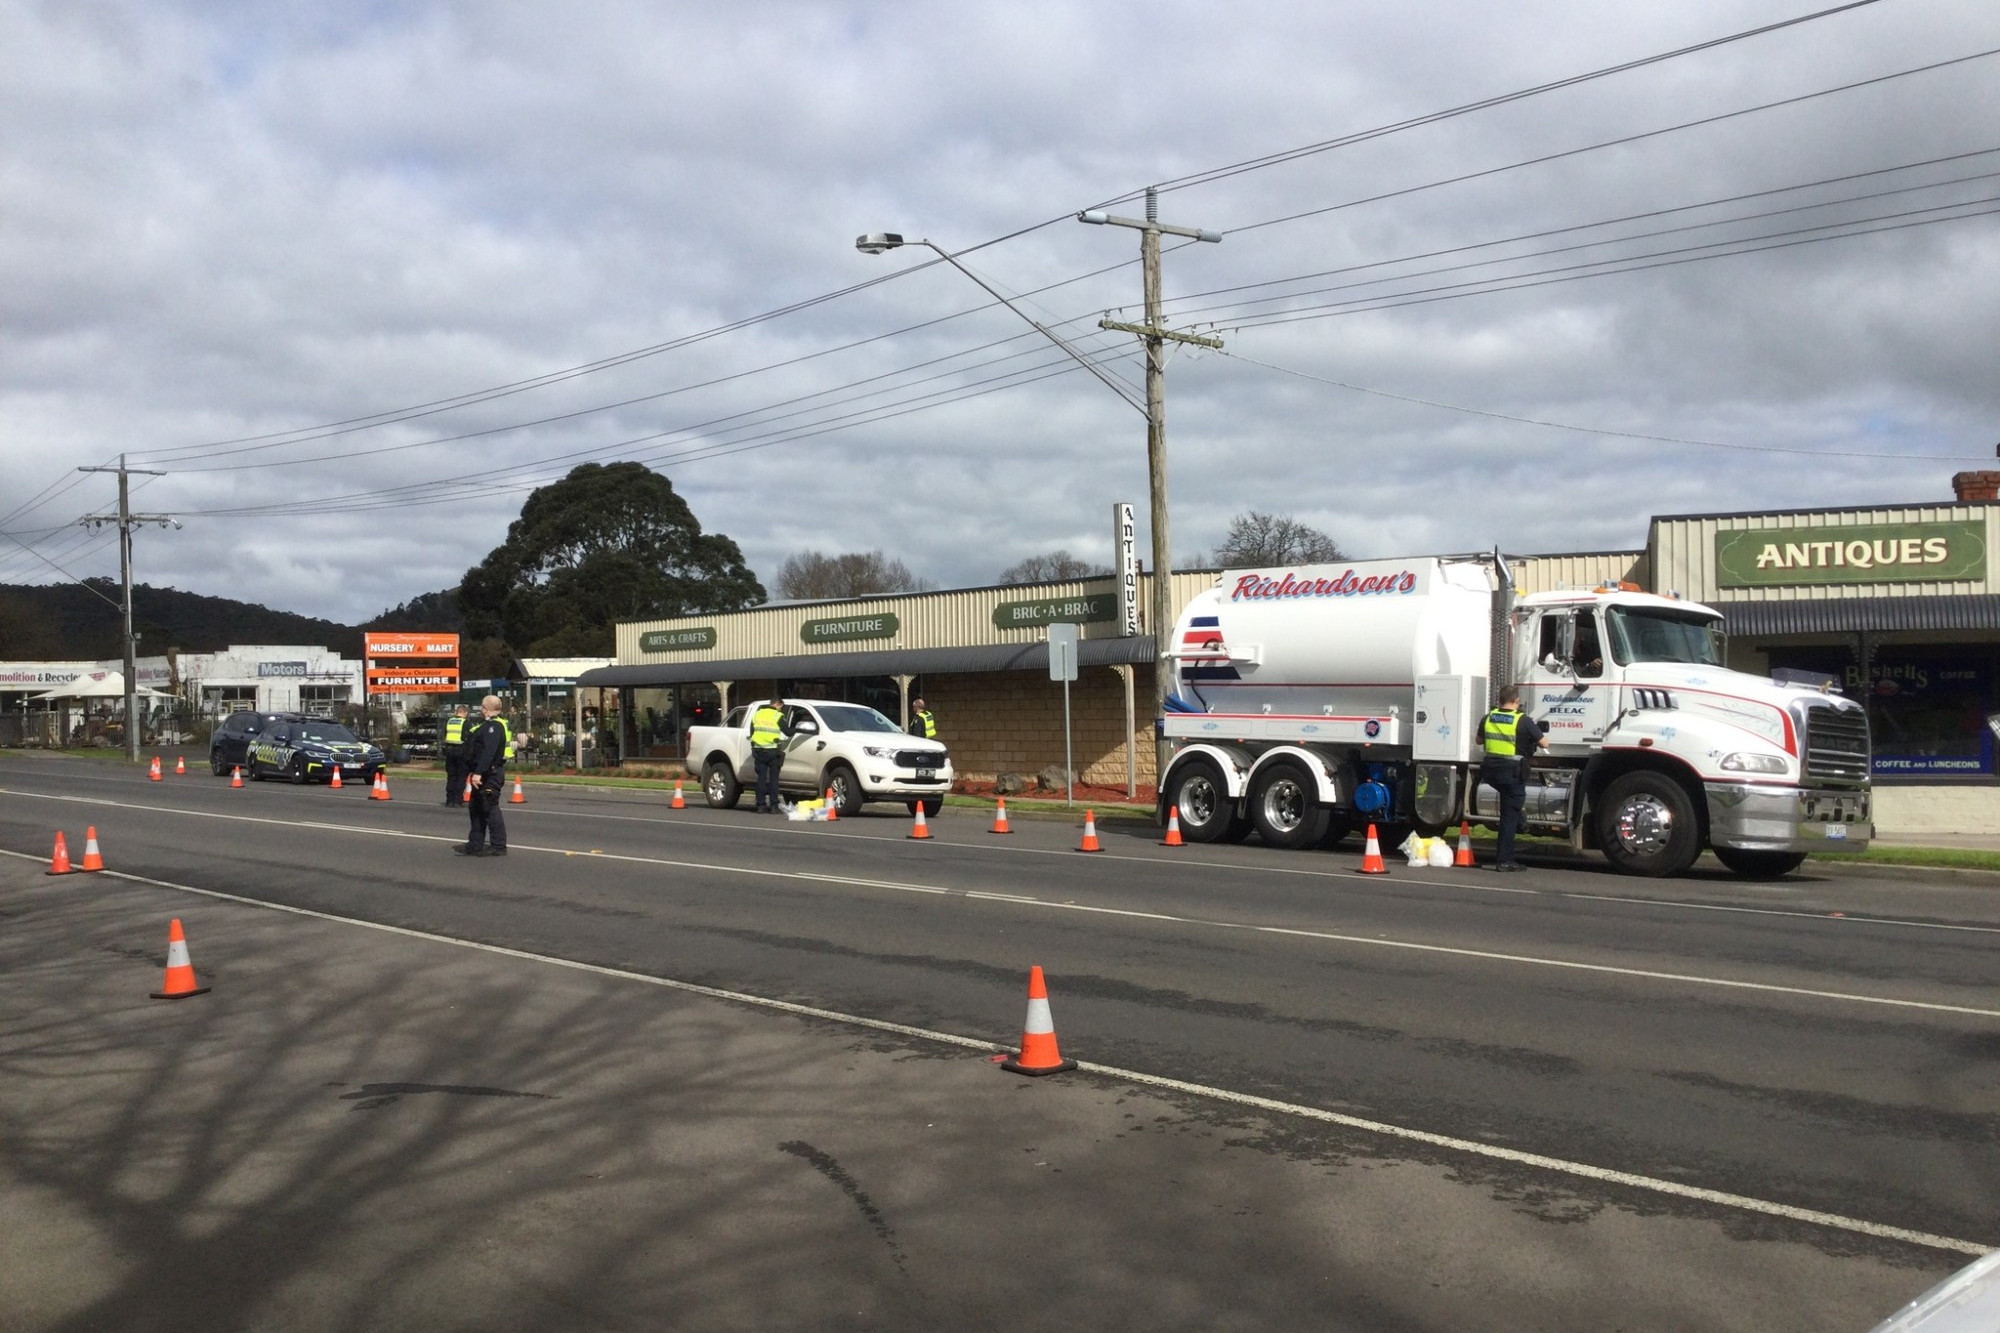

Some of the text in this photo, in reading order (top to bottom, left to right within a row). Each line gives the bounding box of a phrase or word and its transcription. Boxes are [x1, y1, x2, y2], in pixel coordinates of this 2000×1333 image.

[1757, 537, 1949, 569] ANTIQUES
[1231, 569, 1416, 601] Richardson's
[814, 619, 883, 635] FURNITURE
[648, 632, 707, 646] ARTS & CRAFTS
[370, 643, 414, 652] NURSERY
[427, 643, 453, 652] MART
[261, 663, 305, 675] Motors
[38, 673, 44, 682] &
[378, 677, 449, 685] FURNITURE
[1549, 707, 1585, 715] BEEAC
[1875, 760, 1911, 768] COFFEE
[1928, 760, 1980, 768] LUNCHEONS
